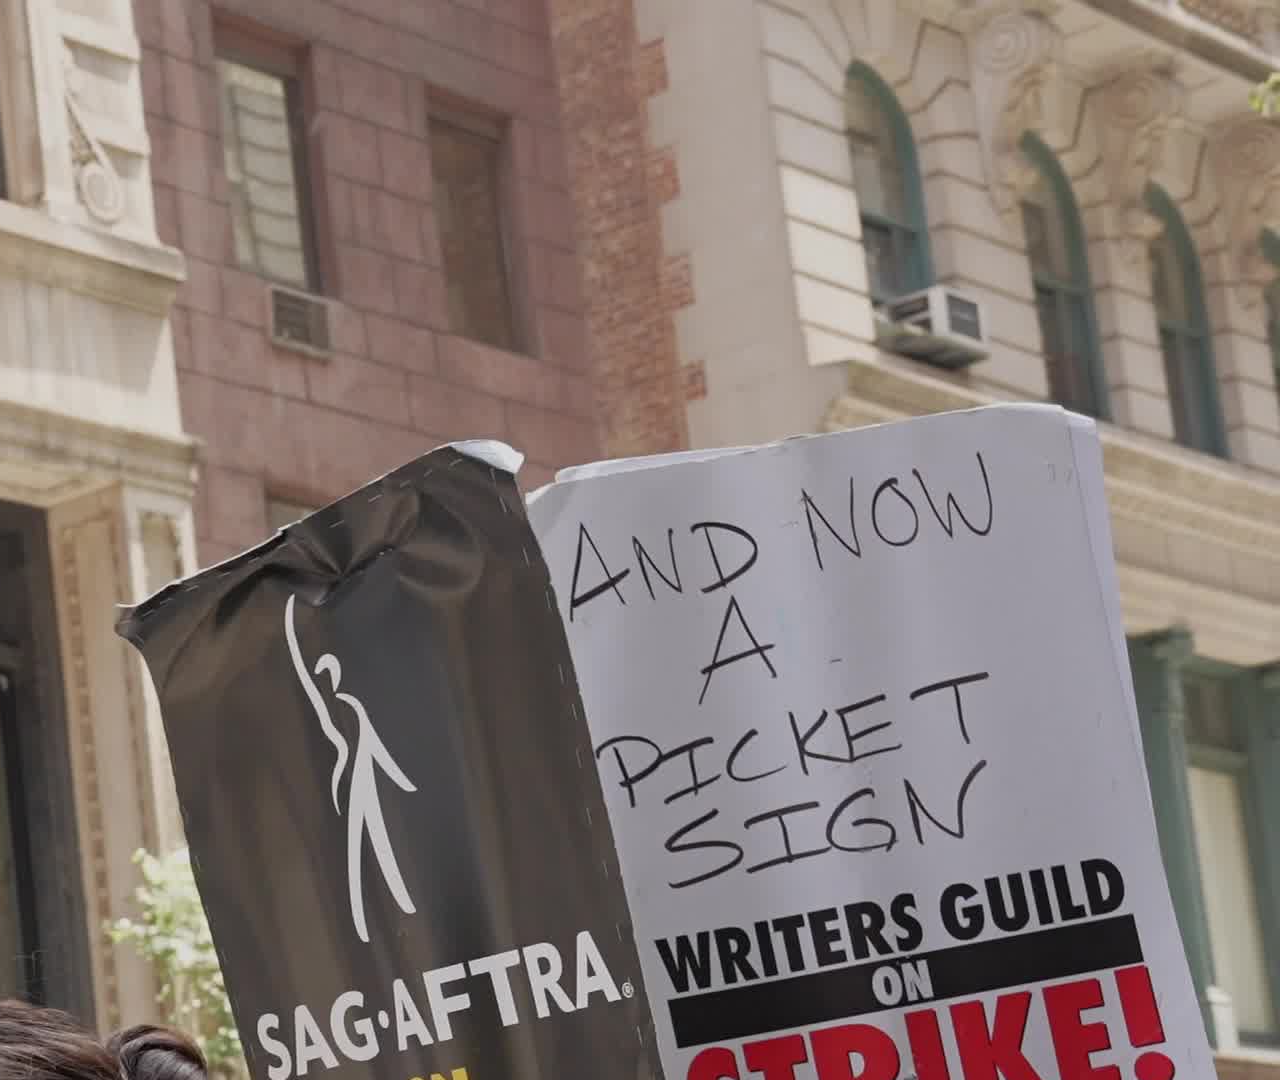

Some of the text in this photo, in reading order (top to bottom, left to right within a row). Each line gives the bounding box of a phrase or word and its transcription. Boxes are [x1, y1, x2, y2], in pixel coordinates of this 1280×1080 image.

[569, 452, 993, 622] AND NOW
[699, 596, 778, 705] A
[595, 672, 990, 808] PICKET
[664, 760, 987, 888] SIGN
[654, 858, 1126, 995] WRITERS GUILD
[871, 958, 934, 1007] ON
